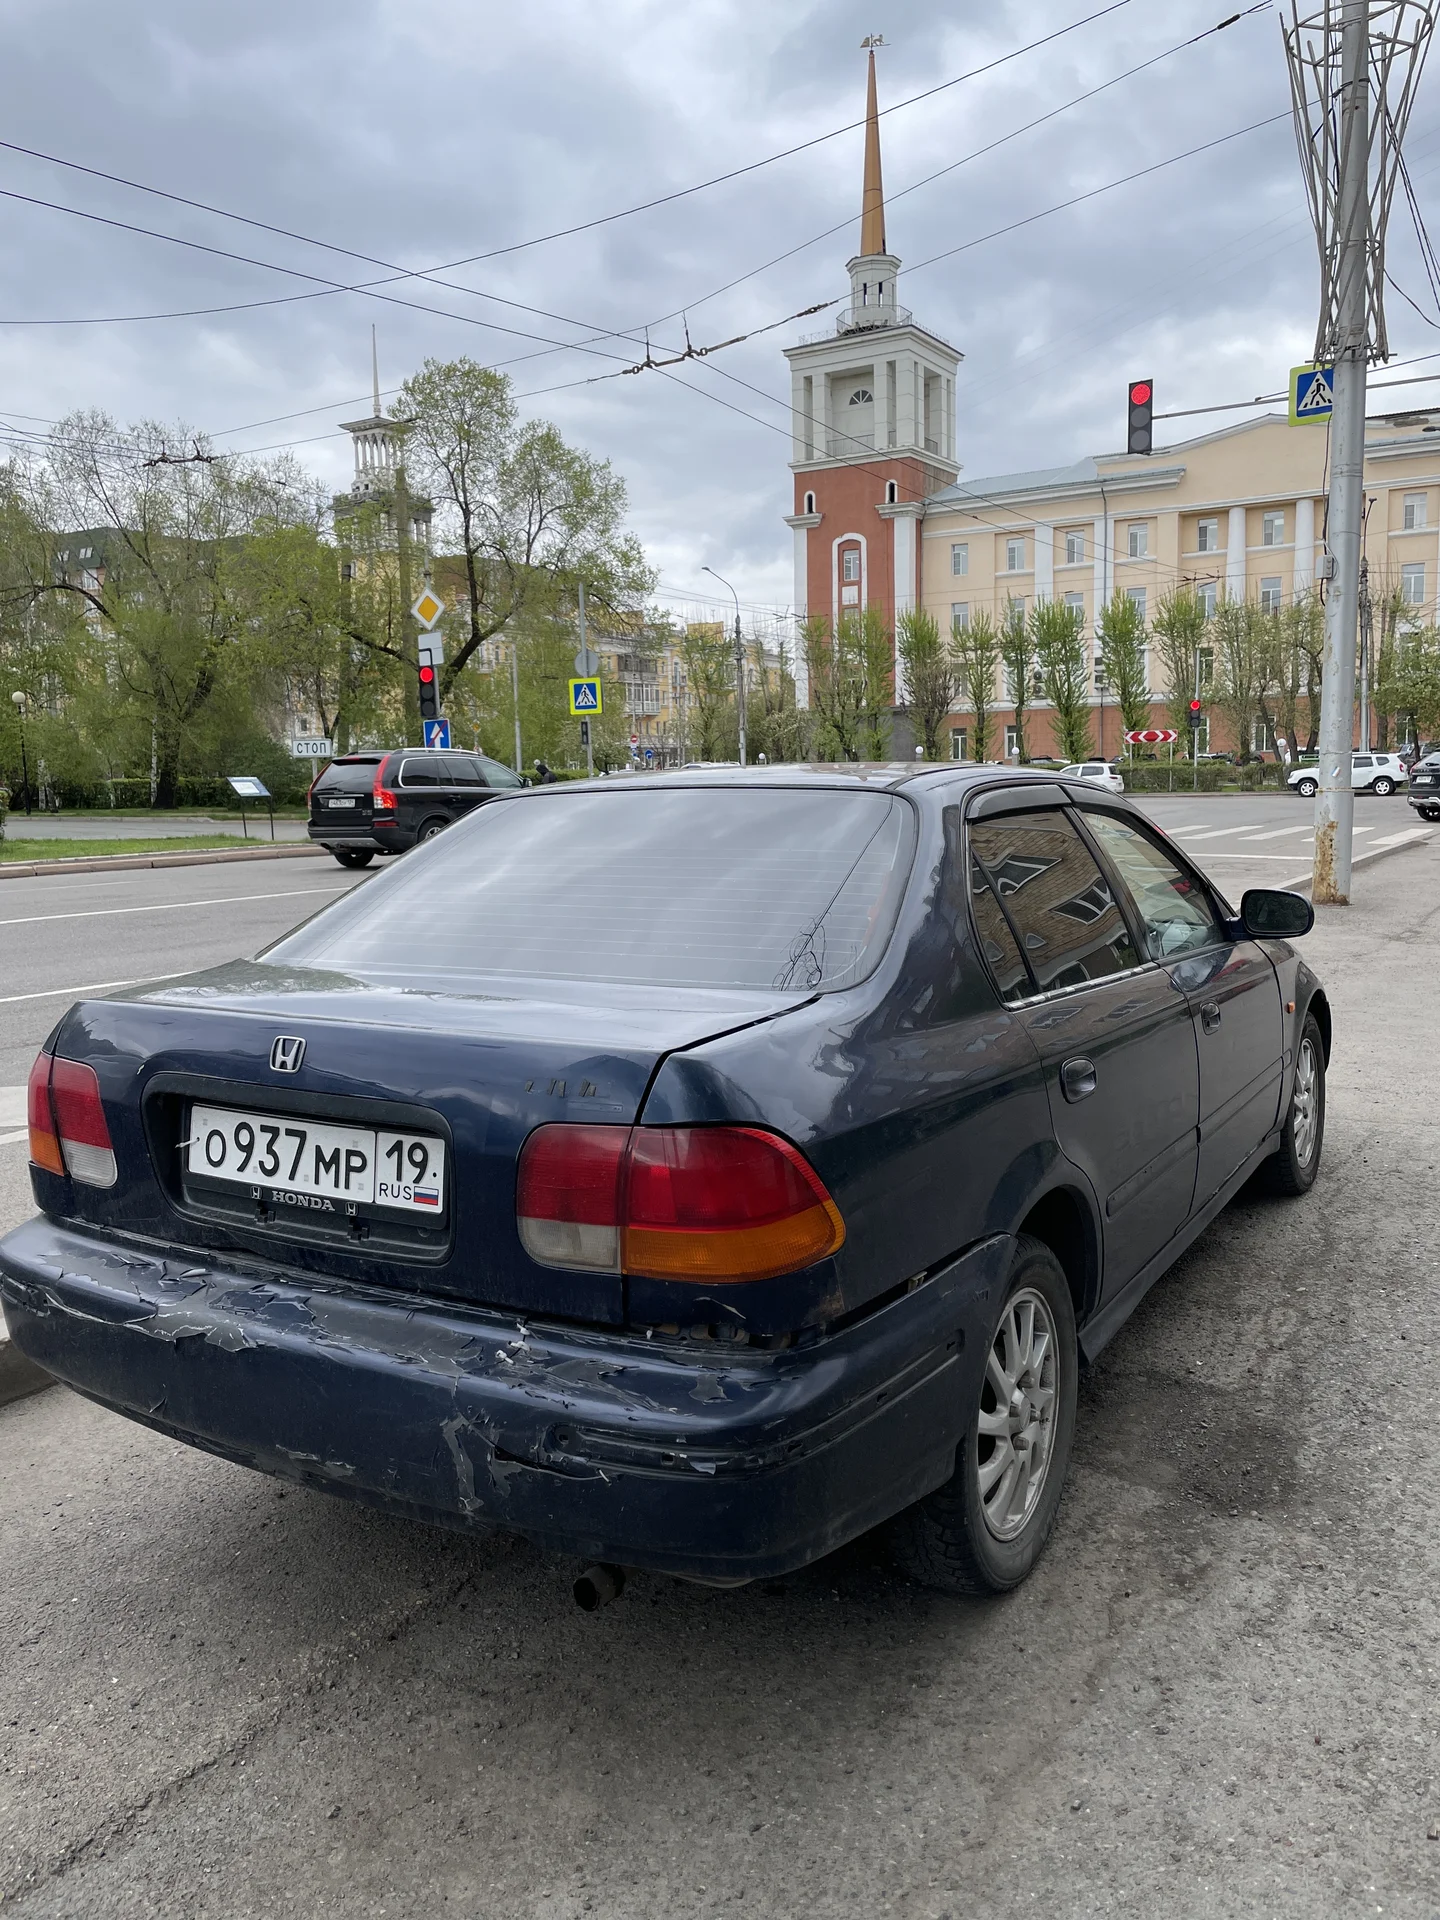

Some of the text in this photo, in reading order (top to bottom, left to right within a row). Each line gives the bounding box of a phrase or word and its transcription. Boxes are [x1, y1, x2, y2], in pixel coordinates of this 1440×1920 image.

[296, 742, 327, 754] СТОП
[271, 1190, 336, 1212] HONDA
[378, 1182, 412, 1201] RUS
